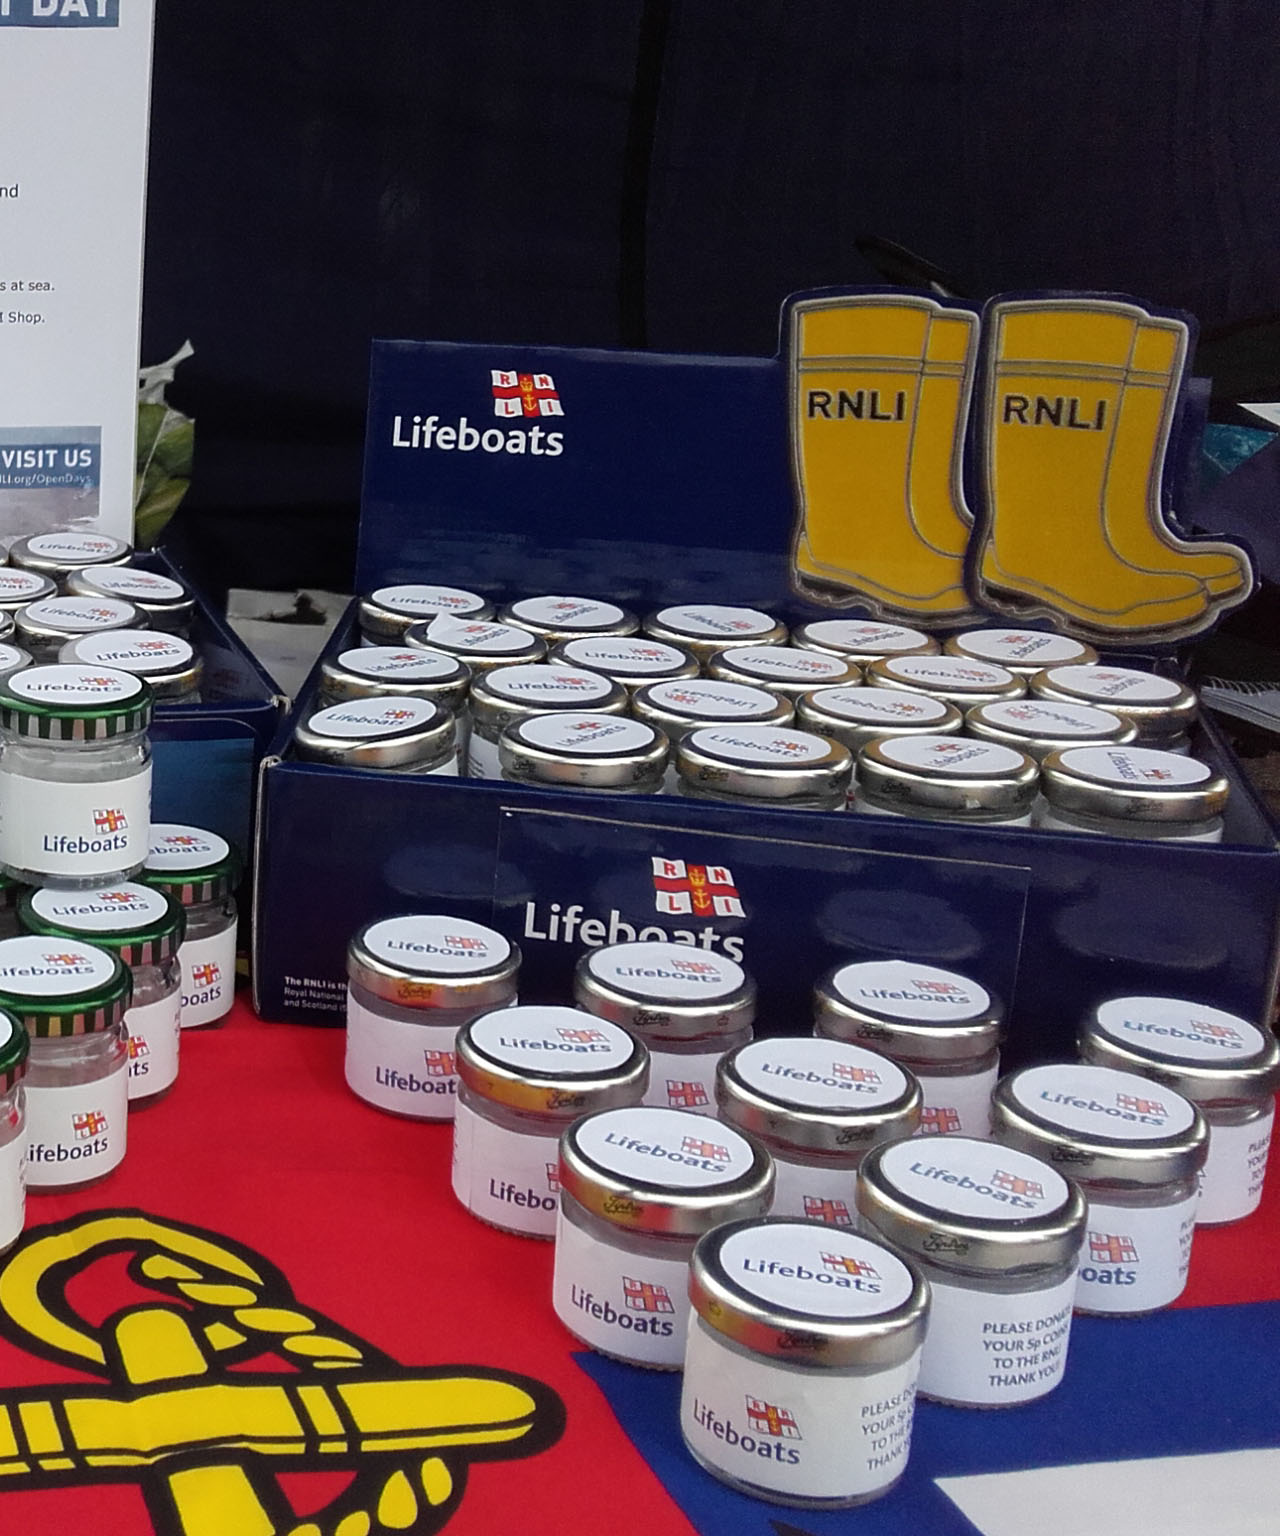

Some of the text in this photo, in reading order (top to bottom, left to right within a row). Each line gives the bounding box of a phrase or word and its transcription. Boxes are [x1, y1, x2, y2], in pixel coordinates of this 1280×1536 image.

[11, 280, 24, 291] at
[28, 282, 55, 291] sea.
[9, 311, 45, 325] Shop.
[807, 389, 906, 424] RNLI
[1002, 394, 1106, 432] RNLI
[392, 415, 565, 458] Lifeboats
[1, 450, 57, 468] VISIT
[65, 449, 92, 467] US
[40, 606, 110, 623] Lifeboats
[96, 648, 181, 661] Lifeboats
[584, 651, 673, 664] Lifeboats
[26, 682, 122, 693] Lifeboats
[507, 681, 600, 691] Lifeboats
[325, 714, 404, 726] Lifeboats
[709, 735, 801, 759] Lifeboats
[44, 835, 128, 855] Lifeboats
[52, 903, 150, 916] Lifeboats
[386, 939, 488, 960] Lifeboats
[284, 976, 326, 989] The RNLI
[616, 966, 723, 984] Lifeboats
[859, 988, 972, 1006] Lifeboats
[1121, 1020, 1244, 1050] Lifeboats
[499, 1036, 612, 1055] Lifeboats
[375, 1066, 457, 1094] Lifeboat
[761, 1062, 879, 1095] Lifeboats
[1039, 1089, 1167, 1126] Lifeboats
[26, 1137, 108, 1162] ifeboats
[604, 1131, 727, 1175] Lifeboats
[490, 1178, 556, 1211] Lifebo
[909, 1160, 1037, 1210] Lifeboats
[742, 1258, 883, 1294] Lifeboats
[570, 1284, 675, 1338] Lifeboats
[983, 1322, 1033, 1335] PLEASE
[983, 1338, 1041, 1352] YOUR 5p
[993, 1354, 1040, 1369] TO THE
[988, 1371, 1036, 1387] THANK
[693, 1396, 802, 1467] Lifeboats
[862, 1415, 896, 1436] YOUR
